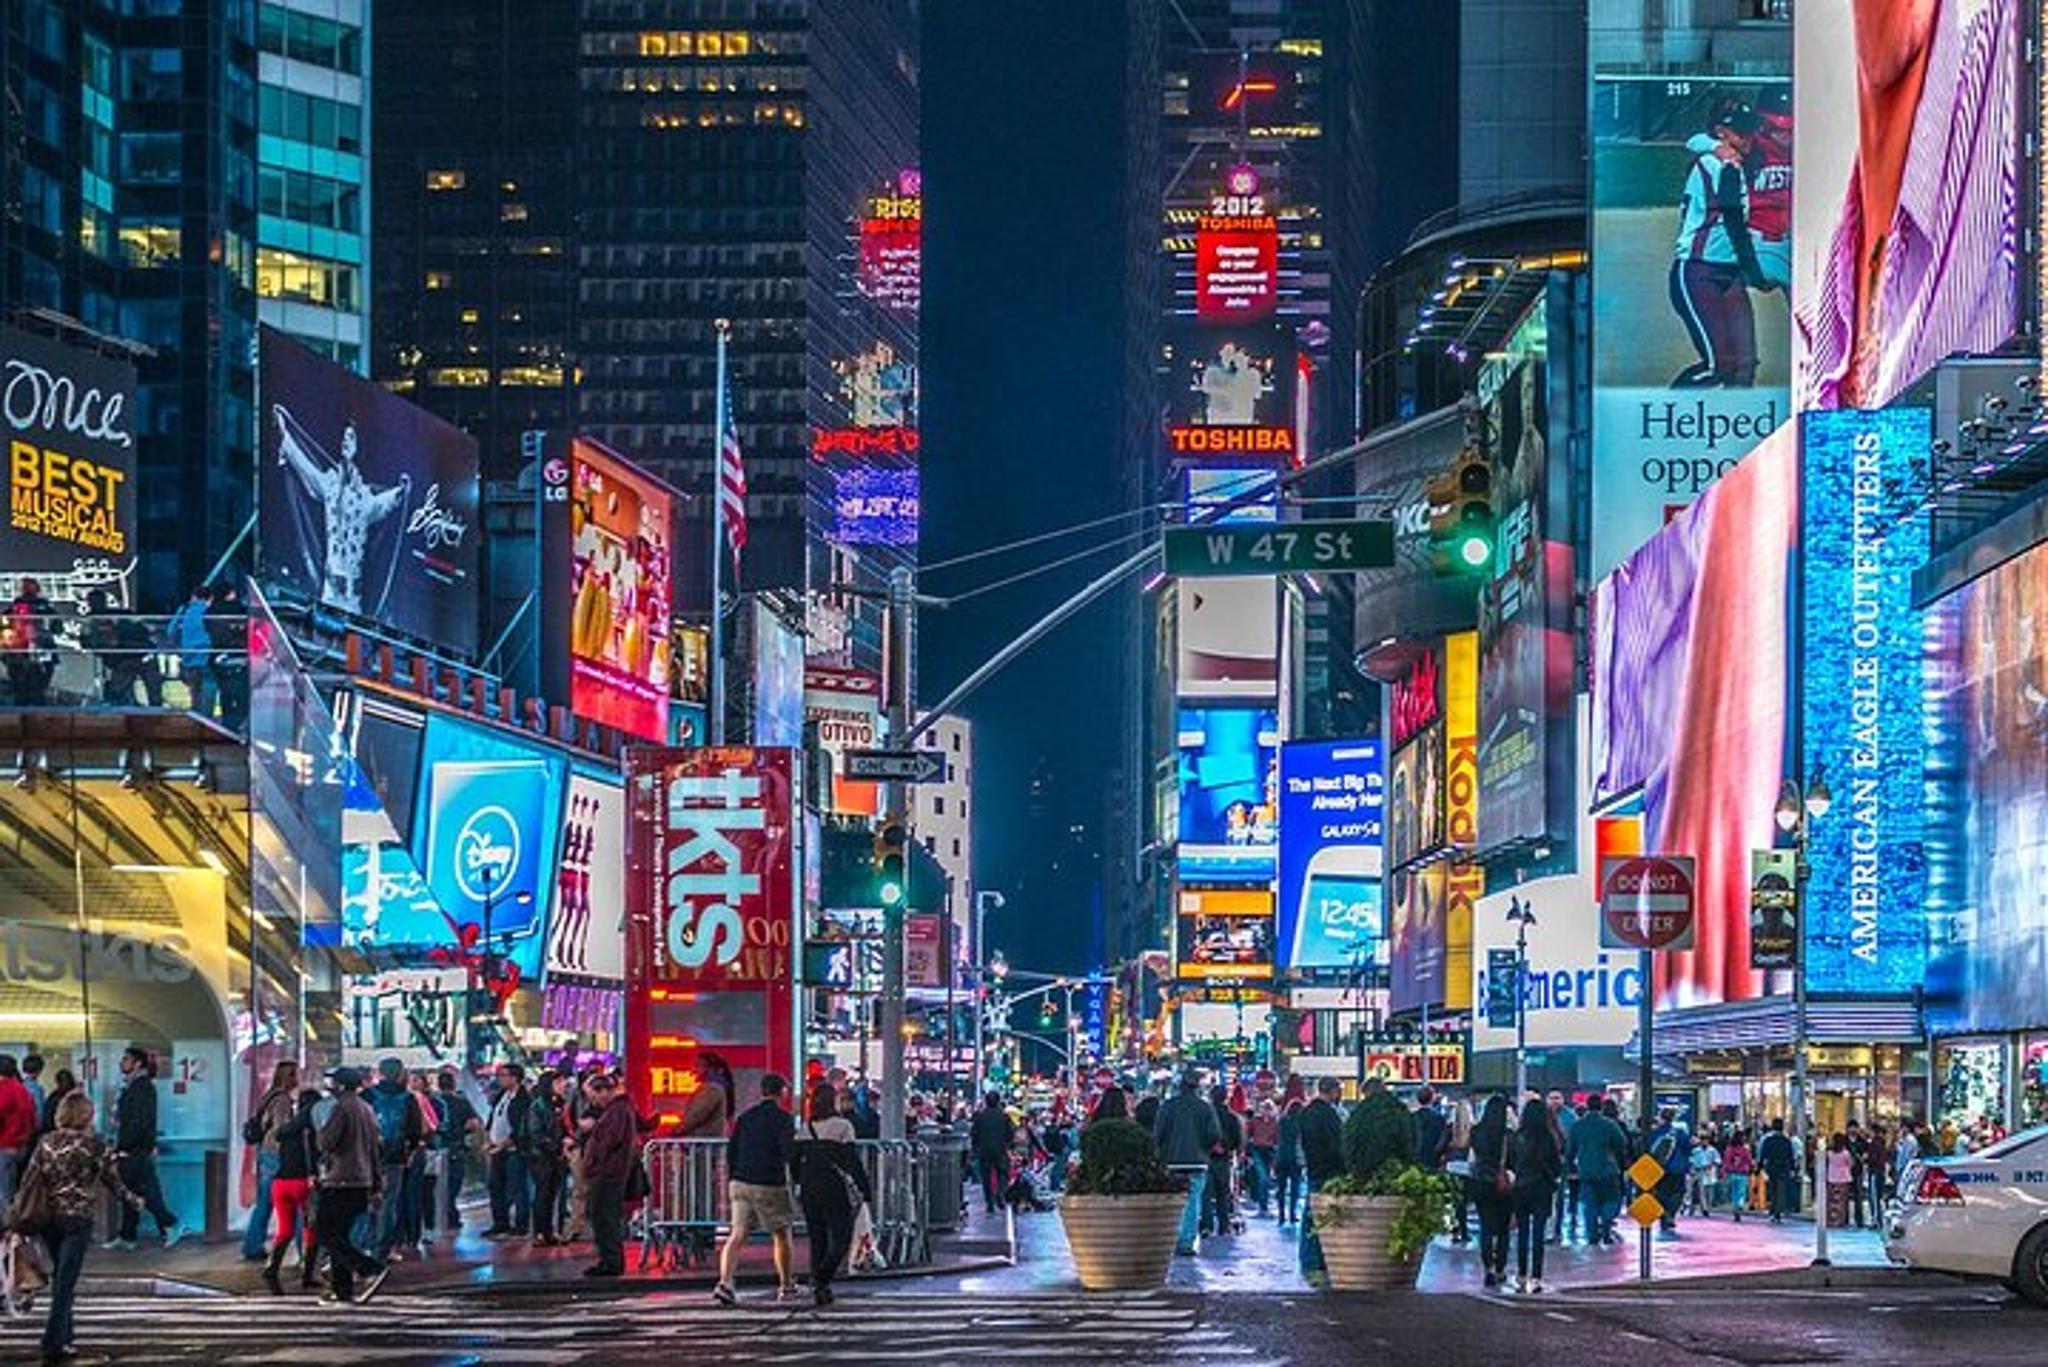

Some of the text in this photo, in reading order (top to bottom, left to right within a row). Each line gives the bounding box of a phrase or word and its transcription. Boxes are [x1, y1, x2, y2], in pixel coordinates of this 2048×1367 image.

[1212, 197, 1265, 216] 2012
[1200, 217, 1276, 230] TOSHIBA
[1640, 400, 1776, 447] Helped
[1172, 429, 1292, 451] TOSHIBA
[10, 440, 125, 512] BEST
[546, 487, 568, 501] LG
[10, 486, 120, 537] MUSICAL
[1206, 531, 1354, 564] W 47 St
[1850, 431, 1883, 964] AMERICAN EAGLE OUTFITTERS
[821, 722, 873, 744] OTIVO
[857, 757, 930, 772] ONE WAY
[1289, 777, 1312, 793] The
[1313, 776, 1342, 792] Next
[1344, 774, 1365, 793] Big
[1312, 794, 1357, 813] Already
[1321, 824, 1362, 838] GALAXY
[668, 768, 767, 969] tkts
[1618, 875, 1641, 890] DO
[1623, 915, 1675, 932] ENER
[1206, 978, 1245, 987] SONY
[1520, 954, 1643, 1012] meric
[177, 1056, 209, 1083] 12
